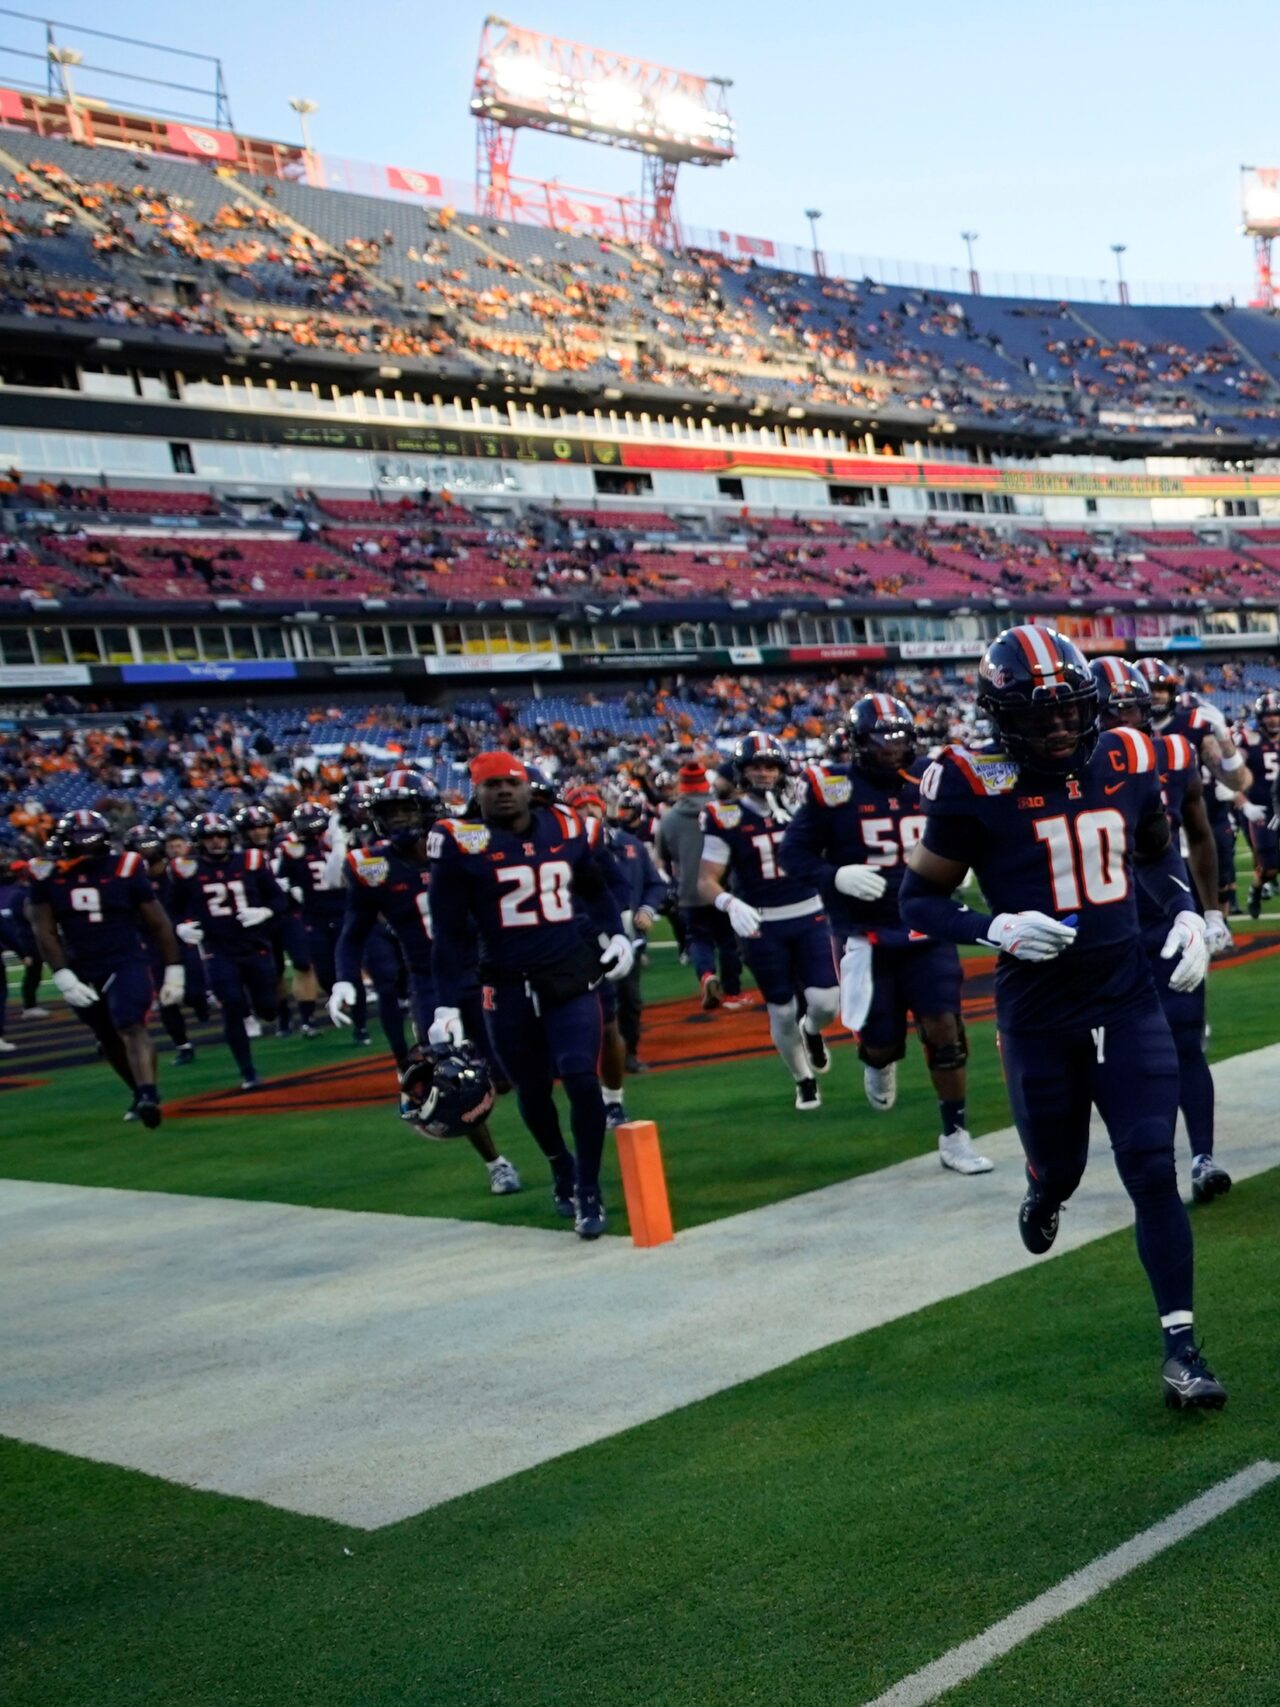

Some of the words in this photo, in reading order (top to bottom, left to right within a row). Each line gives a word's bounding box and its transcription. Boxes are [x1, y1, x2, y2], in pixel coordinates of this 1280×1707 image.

[1108, 750, 1126, 772] C
[1032, 807, 1128, 912] 10
[70, 887, 103, 922] 9
[203, 880, 249, 917] 21
[495, 860, 574, 928] 20
